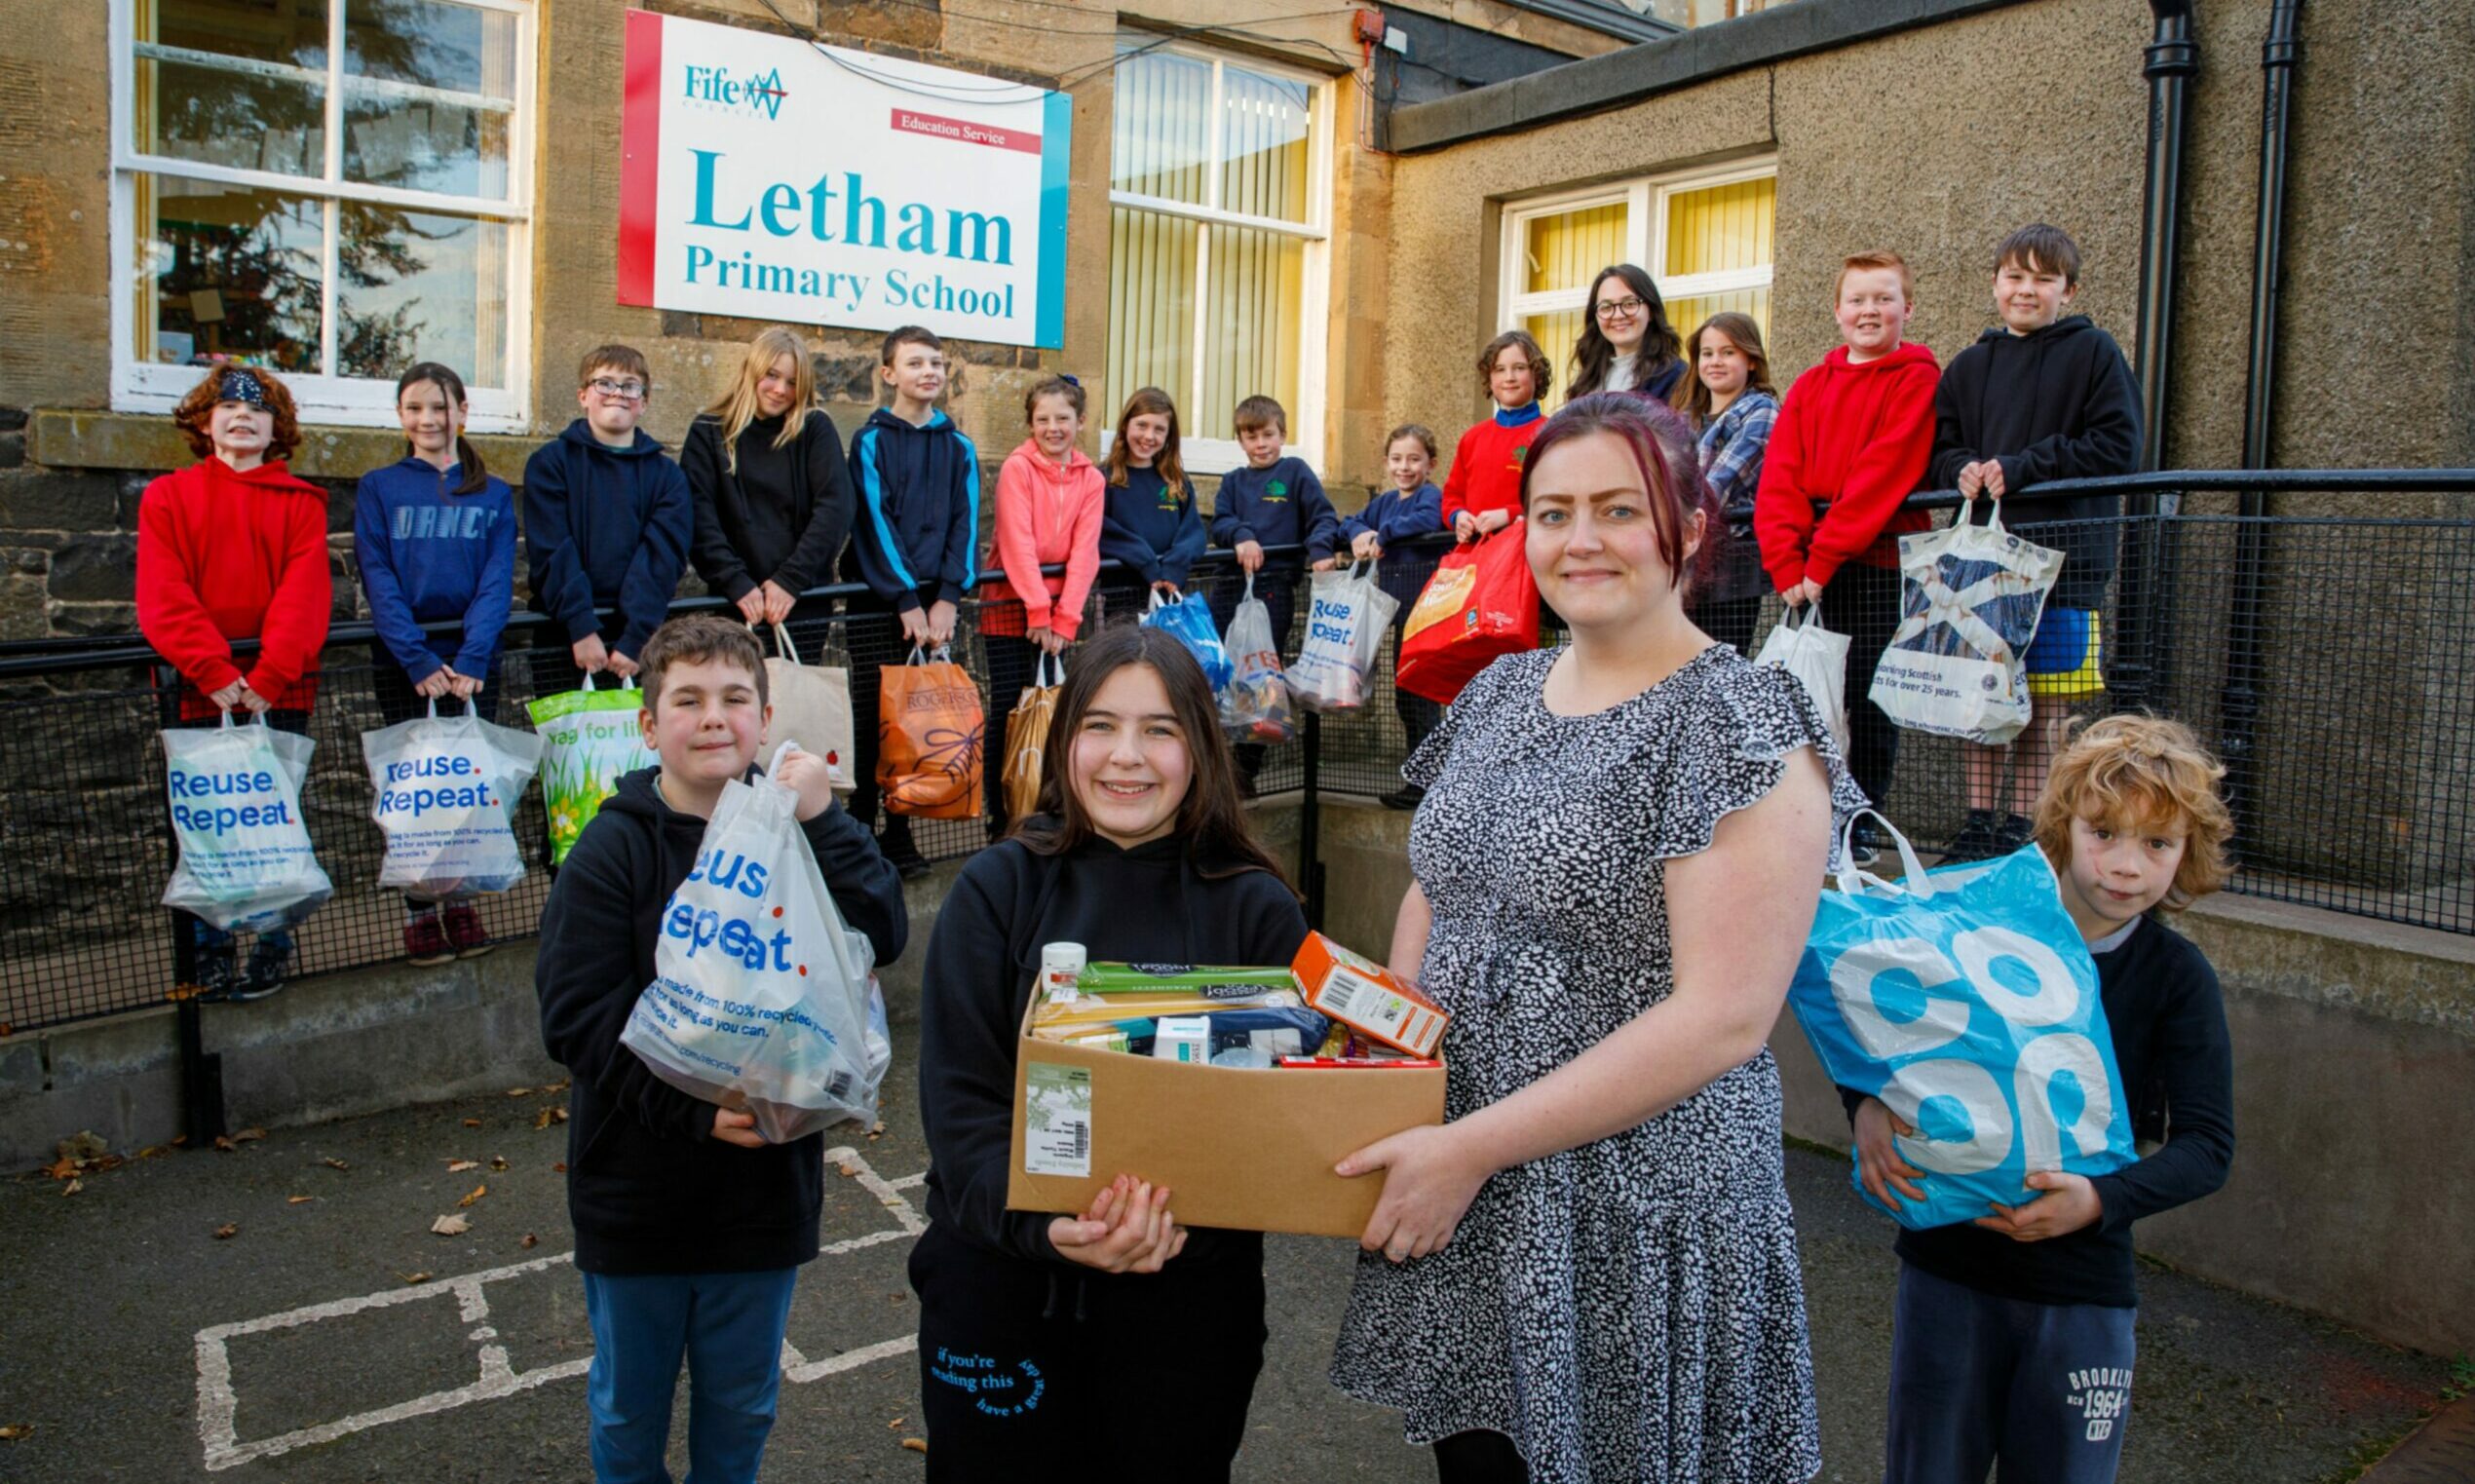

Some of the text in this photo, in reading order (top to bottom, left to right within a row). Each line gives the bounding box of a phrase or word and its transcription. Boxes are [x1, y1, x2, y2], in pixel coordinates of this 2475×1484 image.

[684, 63, 741, 105] Fife
[901, 114, 1007, 145] Education Service
[684, 147, 1015, 266] Letham
[683, 244, 1014, 319] Primary School
[1885, 677, 1898, 688] for
[1900, 681, 1920, 693] over
[1922, 683, 1933, 695] 25
[1935, 686, 1961, 699] years.
[1908, 667, 1942, 682] Scottish
[585, 722, 616, 741] for
[170, 771, 278, 798] Reuse.
[379, 781, 498, 817] Repeat.
[173, 800, 294, 836] Repeat.
[664, 978, 695, 998] made
[694, 990, 720, 1009] from
[723, 1000, 756, 1019] 100%
[700, 1015, 714, 1027] as
[715, 1019, 740, 1035] you
[741, 1025, 770, 1039] can.
[937, 1347, 996, 1369] if you're
[981, 1373, 1014, 1389] this
[976, 1397, 1010, 1417] have
[1013, 1404, 1024, 1414] a
[2083, 1389, 2123, 1419] 1964
